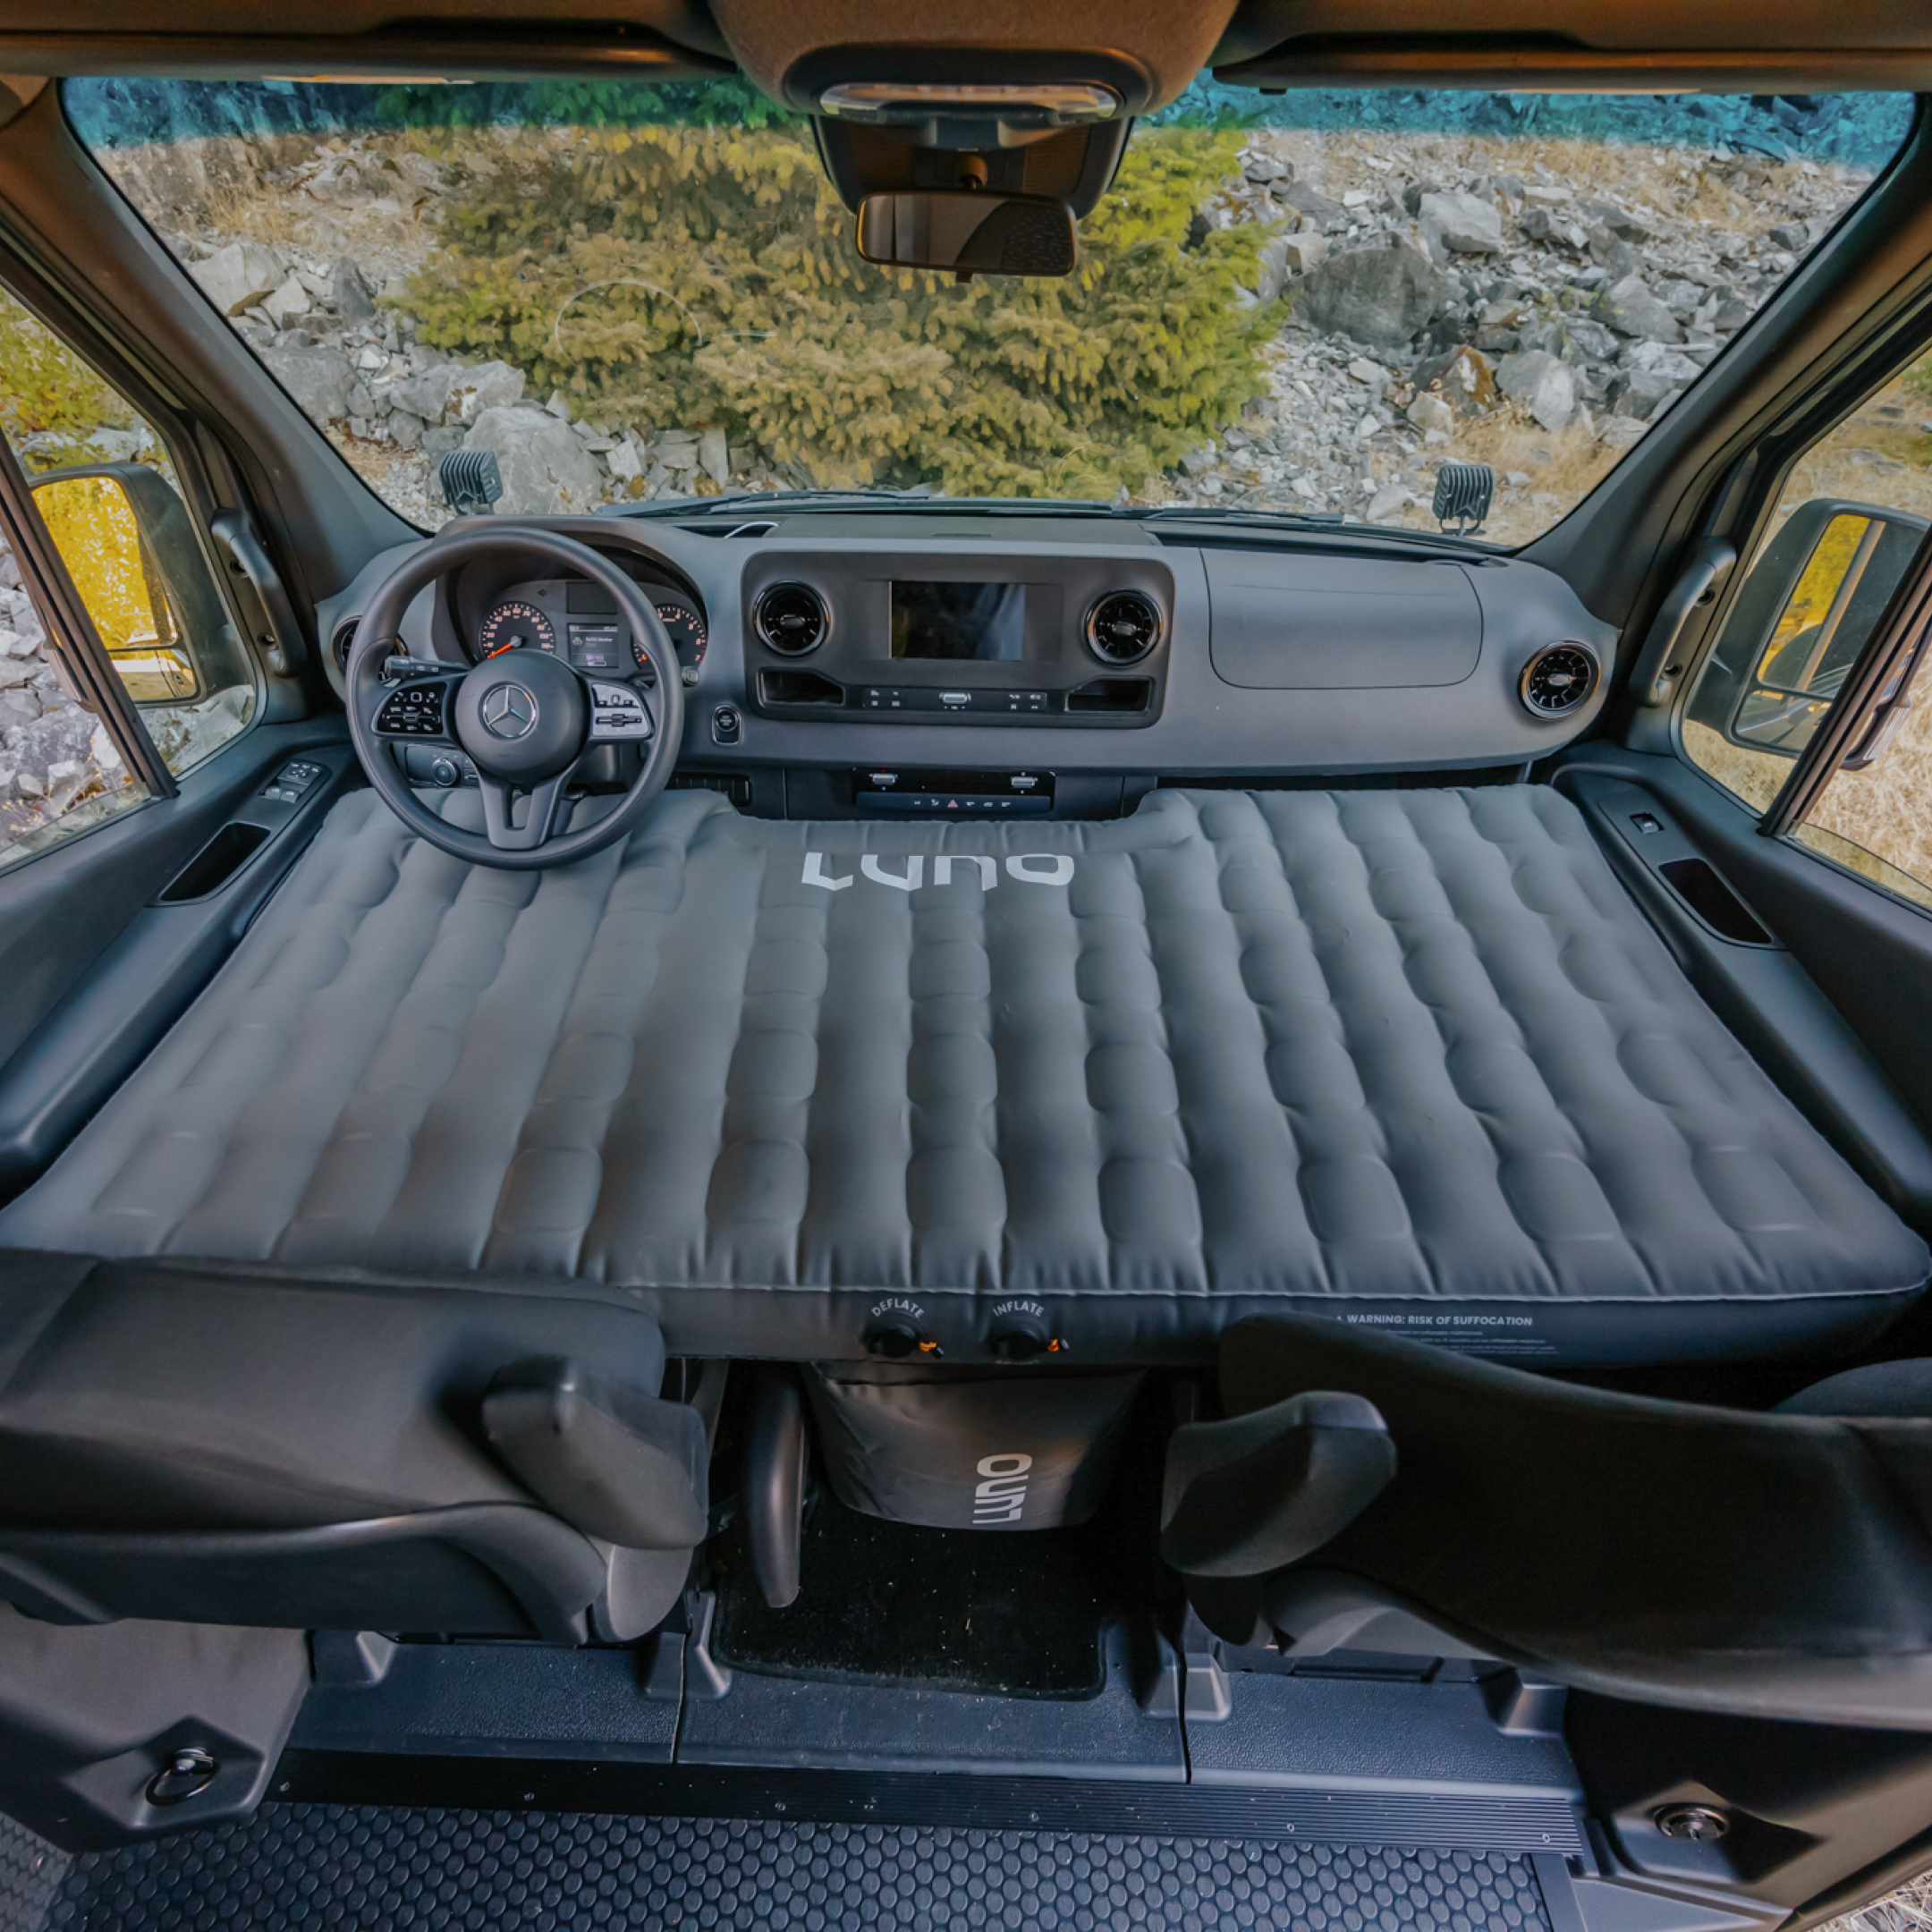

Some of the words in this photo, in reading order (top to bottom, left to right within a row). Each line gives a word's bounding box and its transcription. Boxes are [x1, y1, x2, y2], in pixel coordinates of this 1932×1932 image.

[871, 1298, 924, 1318] DEFLATE
[993, 1300, 1045, 1318] INFLATE
[1347, 1314, 1406, 1325] WARNING:
[1408, 1316, 1433, 1325] RISK
[1436, 1317, 1451, 1326] OF
[1453, 1316, 1533, 1326] SUFFOCATION
